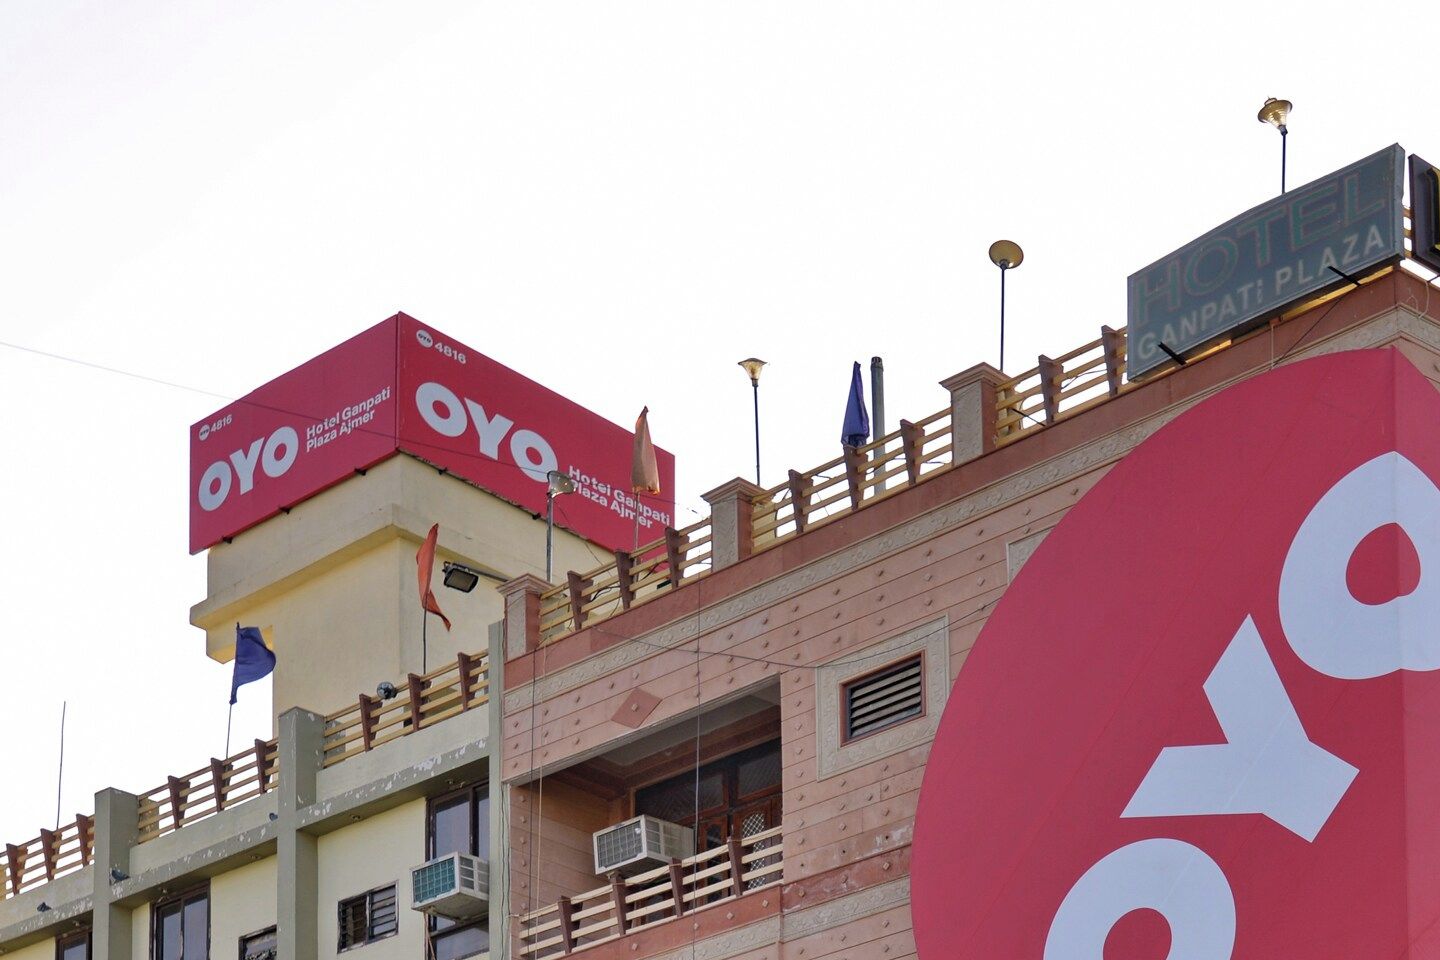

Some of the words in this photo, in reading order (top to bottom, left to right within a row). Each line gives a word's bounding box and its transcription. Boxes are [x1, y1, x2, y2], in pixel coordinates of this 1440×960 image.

[1134, 171, 1387, 328] HOTEL
[1274, 224, 1385, 296] PLAZA
[435, 342, 467, 365] 4816
[210, 414, 233, 433] 4816
[306, 412, 340, 440] Hotel
[341, 386, 391, 421] Ganpati
[306, 429, 337, 453] Plaza
[339, 409, 376, 436] Ajmer
[415, 382, 559, 484] OYO
[198, 426, 299, 512] OYO
[568, 465, 612, 496] Hotel
